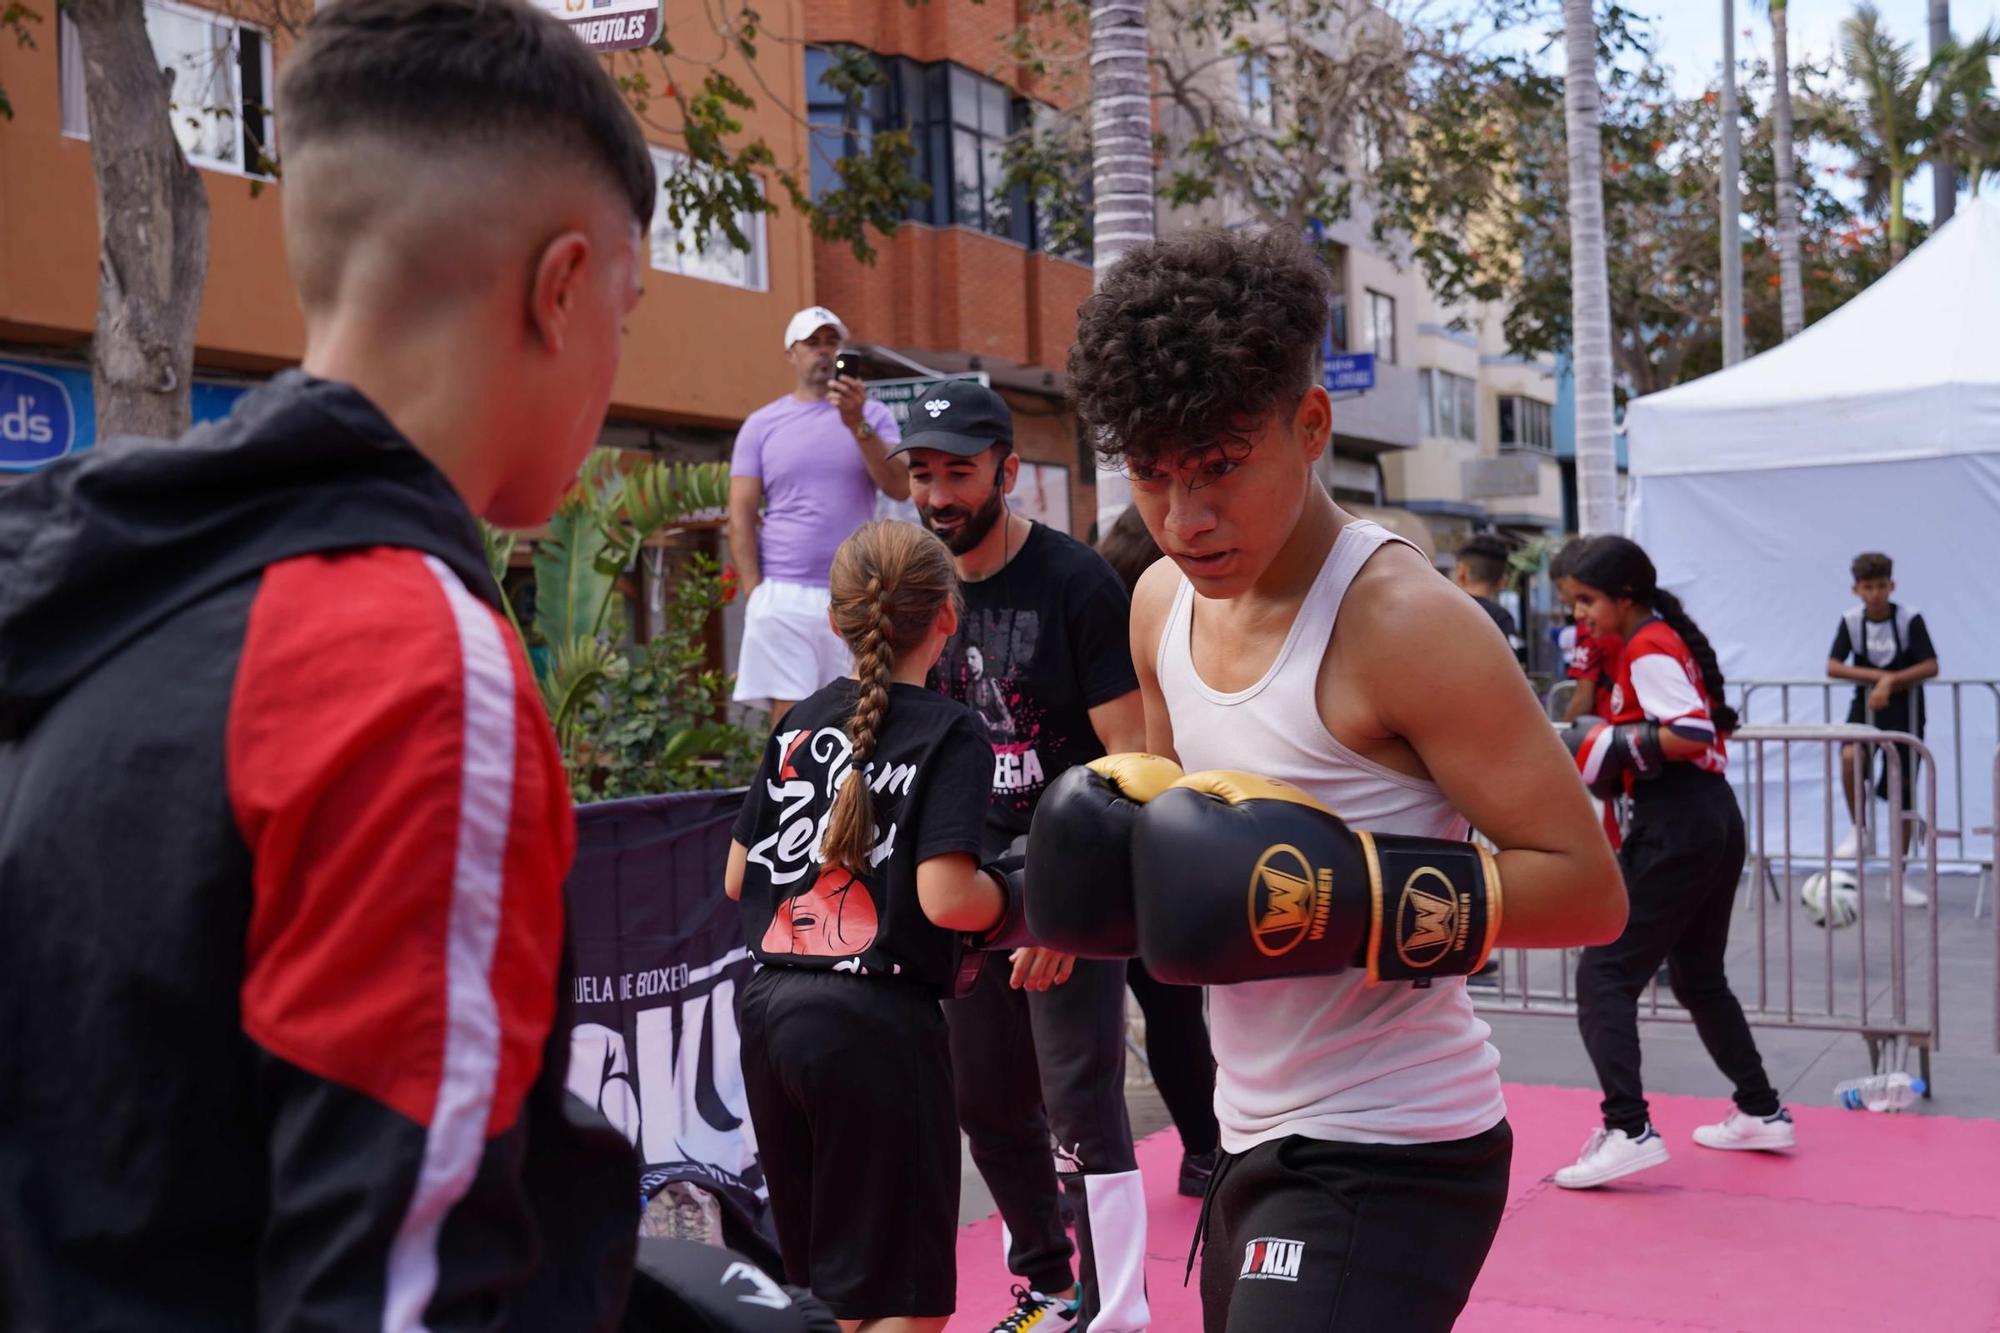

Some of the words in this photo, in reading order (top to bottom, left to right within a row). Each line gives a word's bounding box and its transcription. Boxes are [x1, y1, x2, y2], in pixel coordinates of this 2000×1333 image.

[567, 15, 646, 44] MIENTO.ES
[0, 394, 53, 443] d's
[1309, 867, 1333, 940] WINNER
[1454, 893, 1471, 951] WINNER
[573, 976, 614, 1003] UELA
[620, 973, 634, 1000] DE
[636, 963, 688, 998] BOXEO
